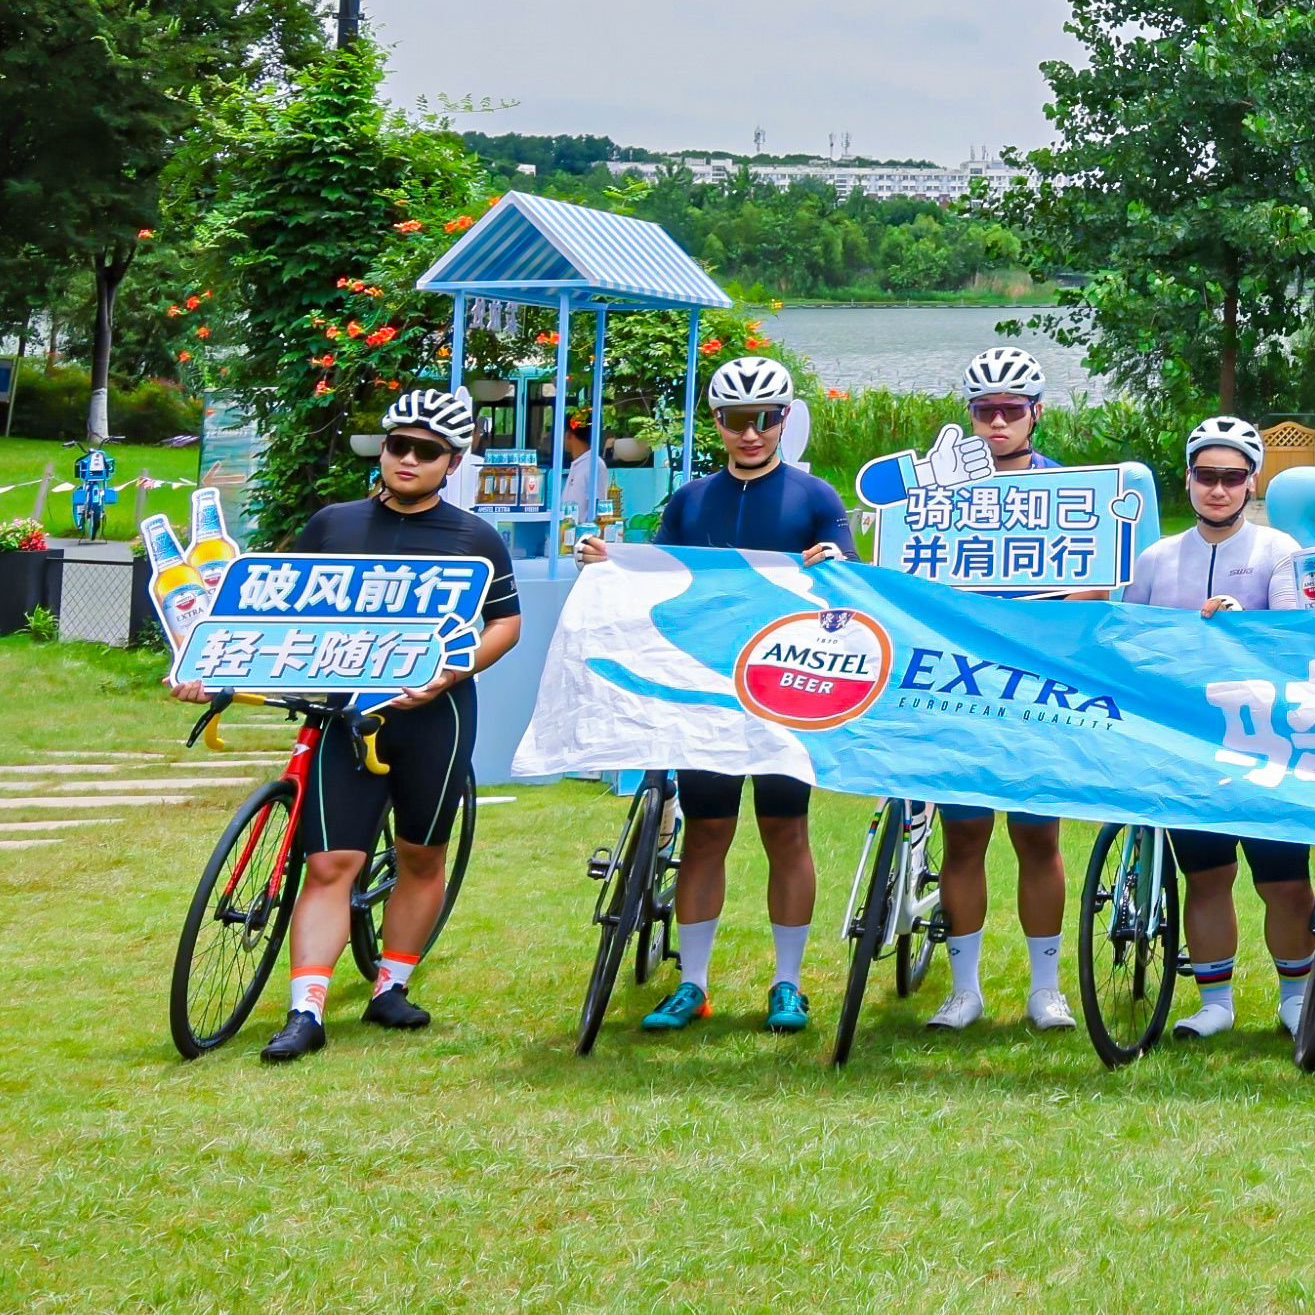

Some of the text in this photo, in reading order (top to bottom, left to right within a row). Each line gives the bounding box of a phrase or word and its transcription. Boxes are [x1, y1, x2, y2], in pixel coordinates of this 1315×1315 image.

[903, 485, 1099, 532] 骑遇知己
[902, 534, 1096, 579] 并肩同行
[237, 562, 475, 615] 破风前行
[176, 607, 204, 622] EXTRA
[195, 628, 436, 681] 轻卡随行
[761, 642, 872, 676] AMSTEL
[779, 671, 835, 695] BEER
[898, 647, 1123, 721] EXTRA
[899, 697, 1114, 731] EUROPEAN QUALITY
